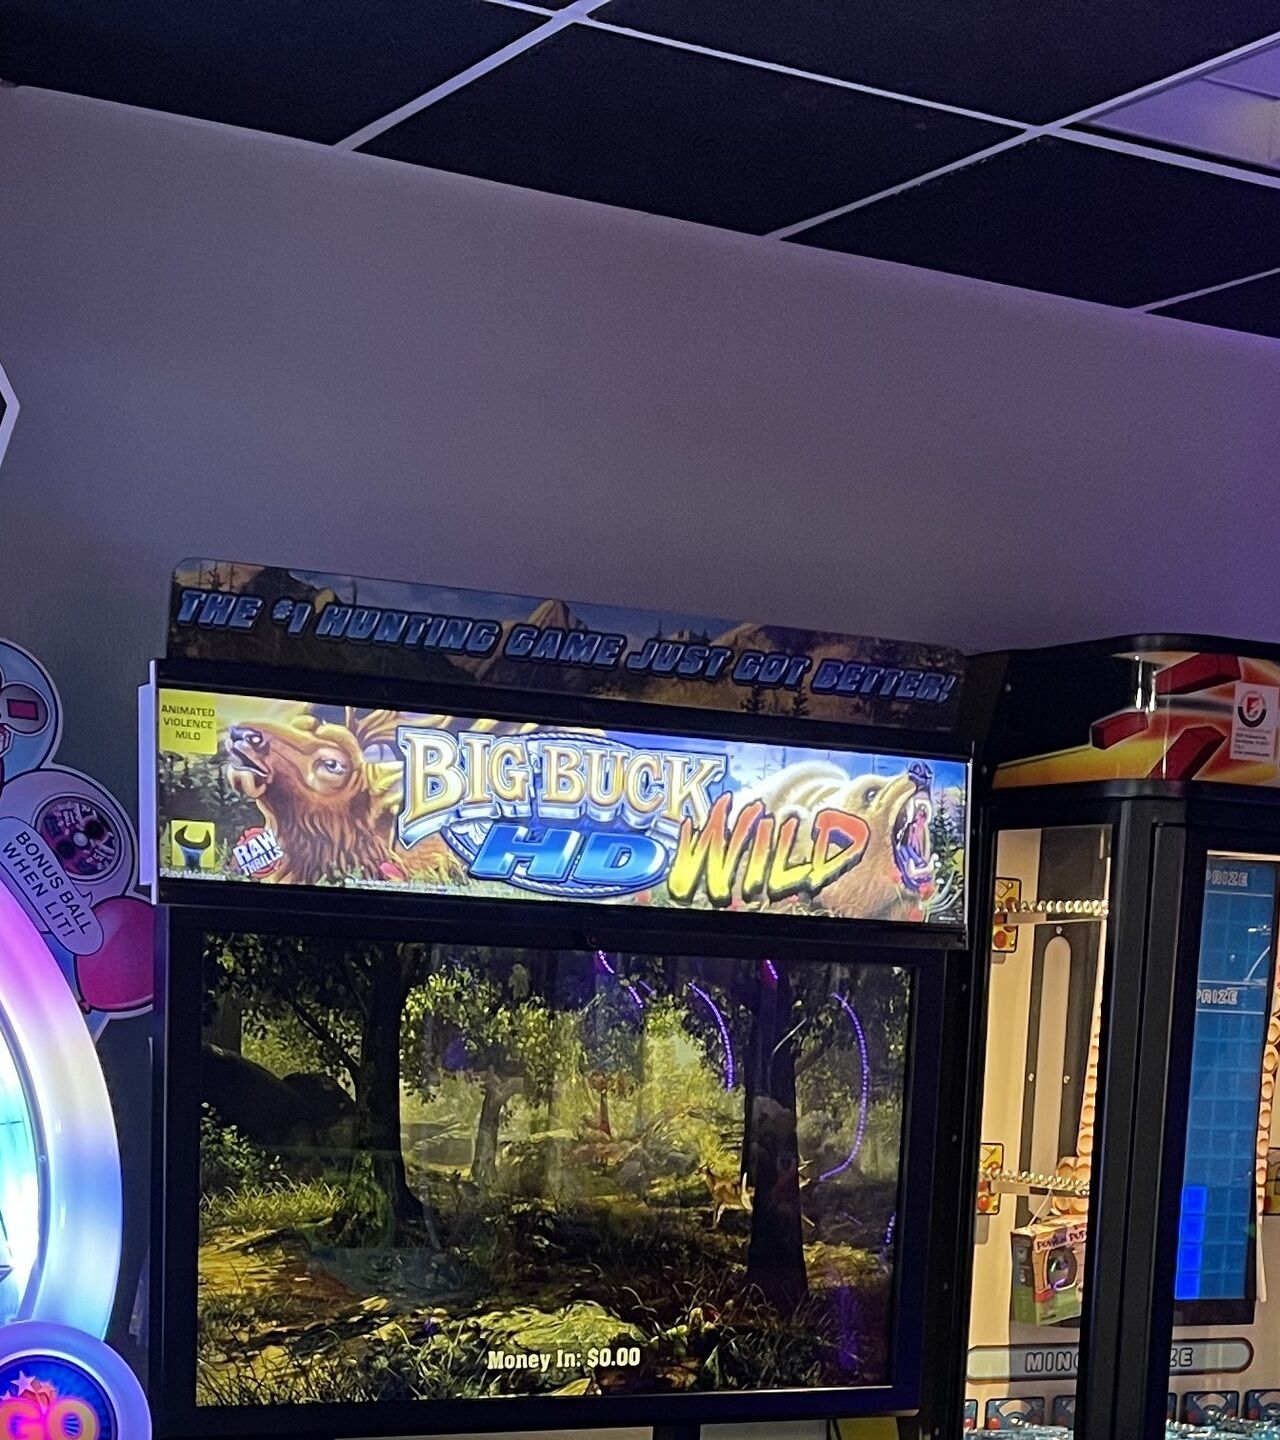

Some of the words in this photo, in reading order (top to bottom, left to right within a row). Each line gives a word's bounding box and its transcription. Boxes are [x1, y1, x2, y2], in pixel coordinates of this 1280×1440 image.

[176, 589, 263, 631] THE
[271, 598, 312, 636] #1
[316, 604, 502, 655] HUNTING
[504, 620, 626, 669] GAME
[627, 640, 731, 680] JUST
[733, 652, 812, 689] GOT
[810, 659, 959, 702] BETTER!
[161, 704, 216, 718] ANIMATED
[163, 717, 214, 731] VIOLENCE
[175, 730, 201, 742] MILD
[398, 726, 532, 848] BIG
[541, 742, 728, 840] BUCK
[233, 829, 279, 862] RAW
[240, 844, 284, 876] THRILLS
[467, 821, 670, 886] HD
[666, 791, 872, 907] WILD
[1, 839, 48, 898] WHEN
[43, 890, 78, 937] LIT!
[13, 829, 66, 891] BONUS
[59, 886, 93, 936] BALL
[487, 1350, 551, 1373] Money
[557, 1348, 581, 1368] In:
[587, 1346, 641, 1369] $0.00
